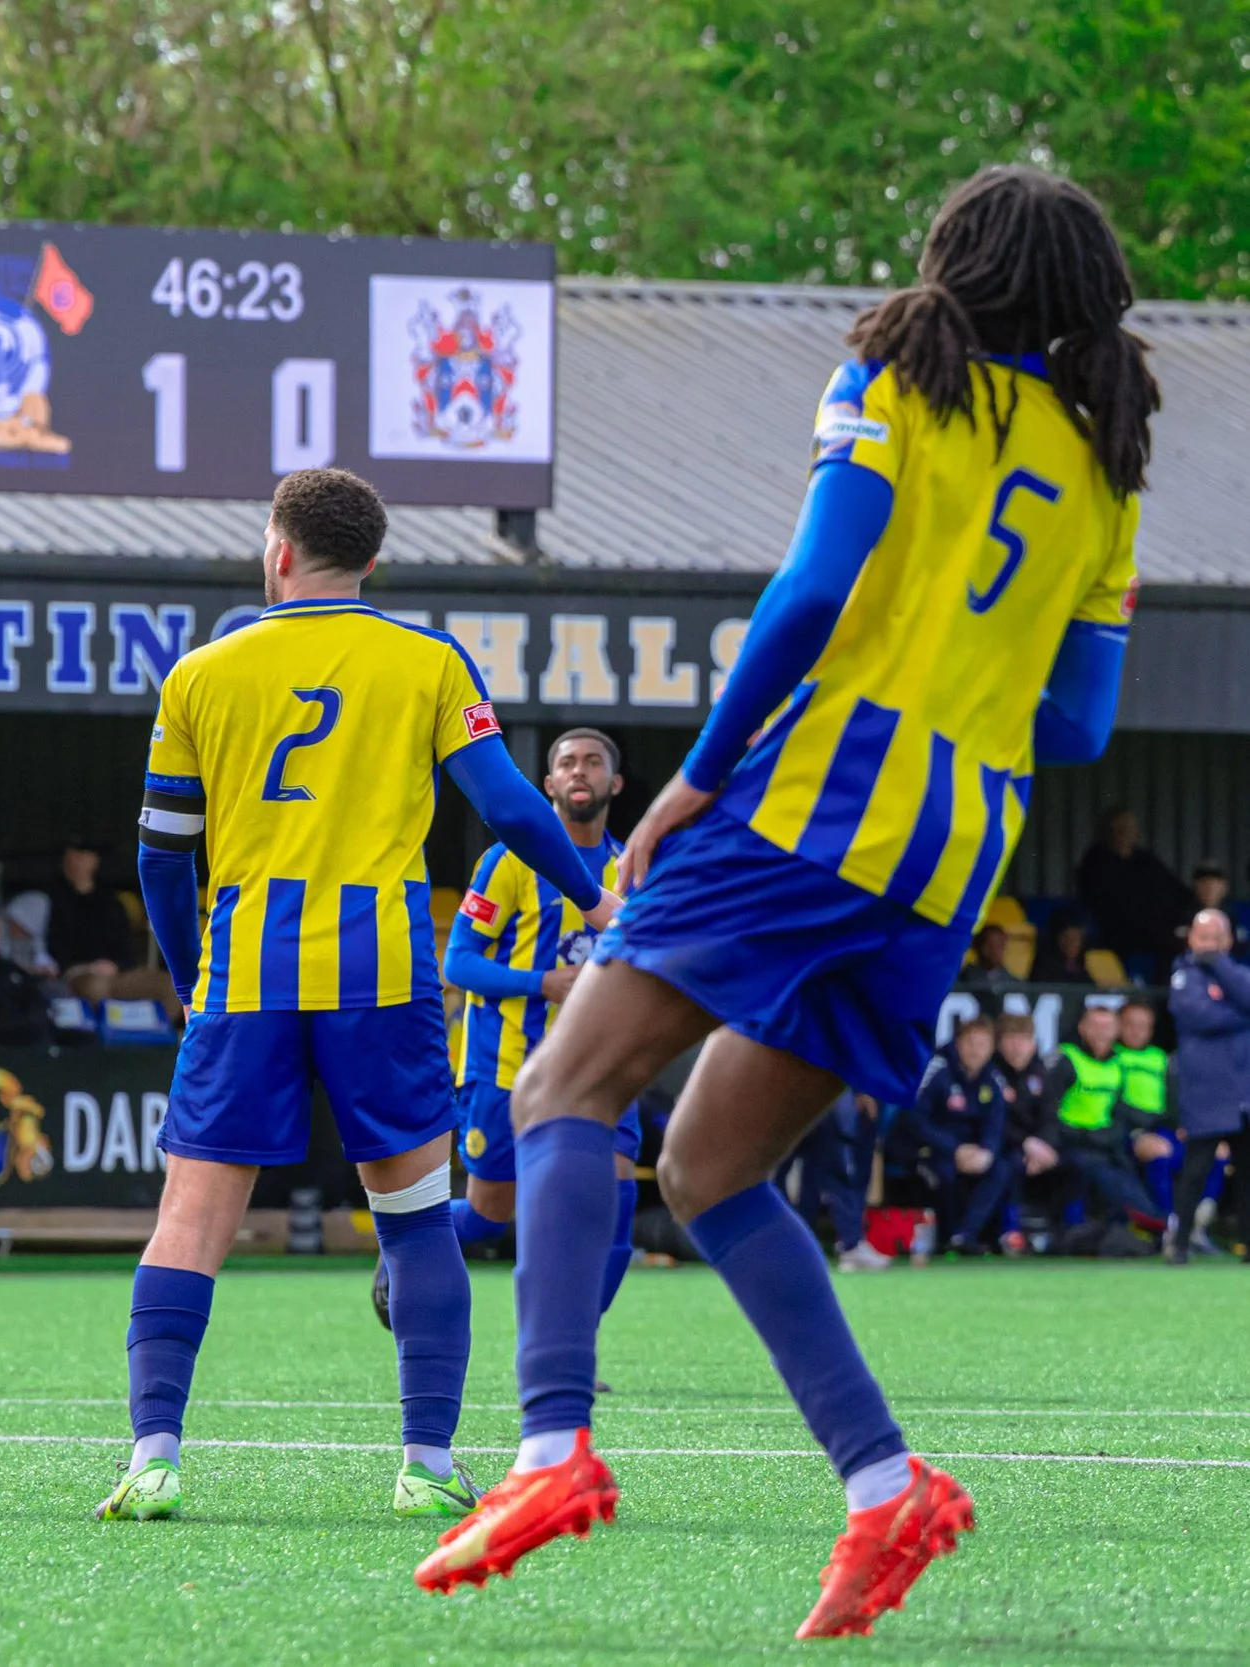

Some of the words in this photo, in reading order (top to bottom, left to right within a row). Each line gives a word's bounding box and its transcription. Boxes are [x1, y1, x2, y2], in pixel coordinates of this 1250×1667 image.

[152, 256, 304, 323] 46:23
[141, 352, 187, 473] 1
[271, 357, 337, 475] 0
[966, 465, 1063, 615] 5
[259, 686, 344, 802] 2
